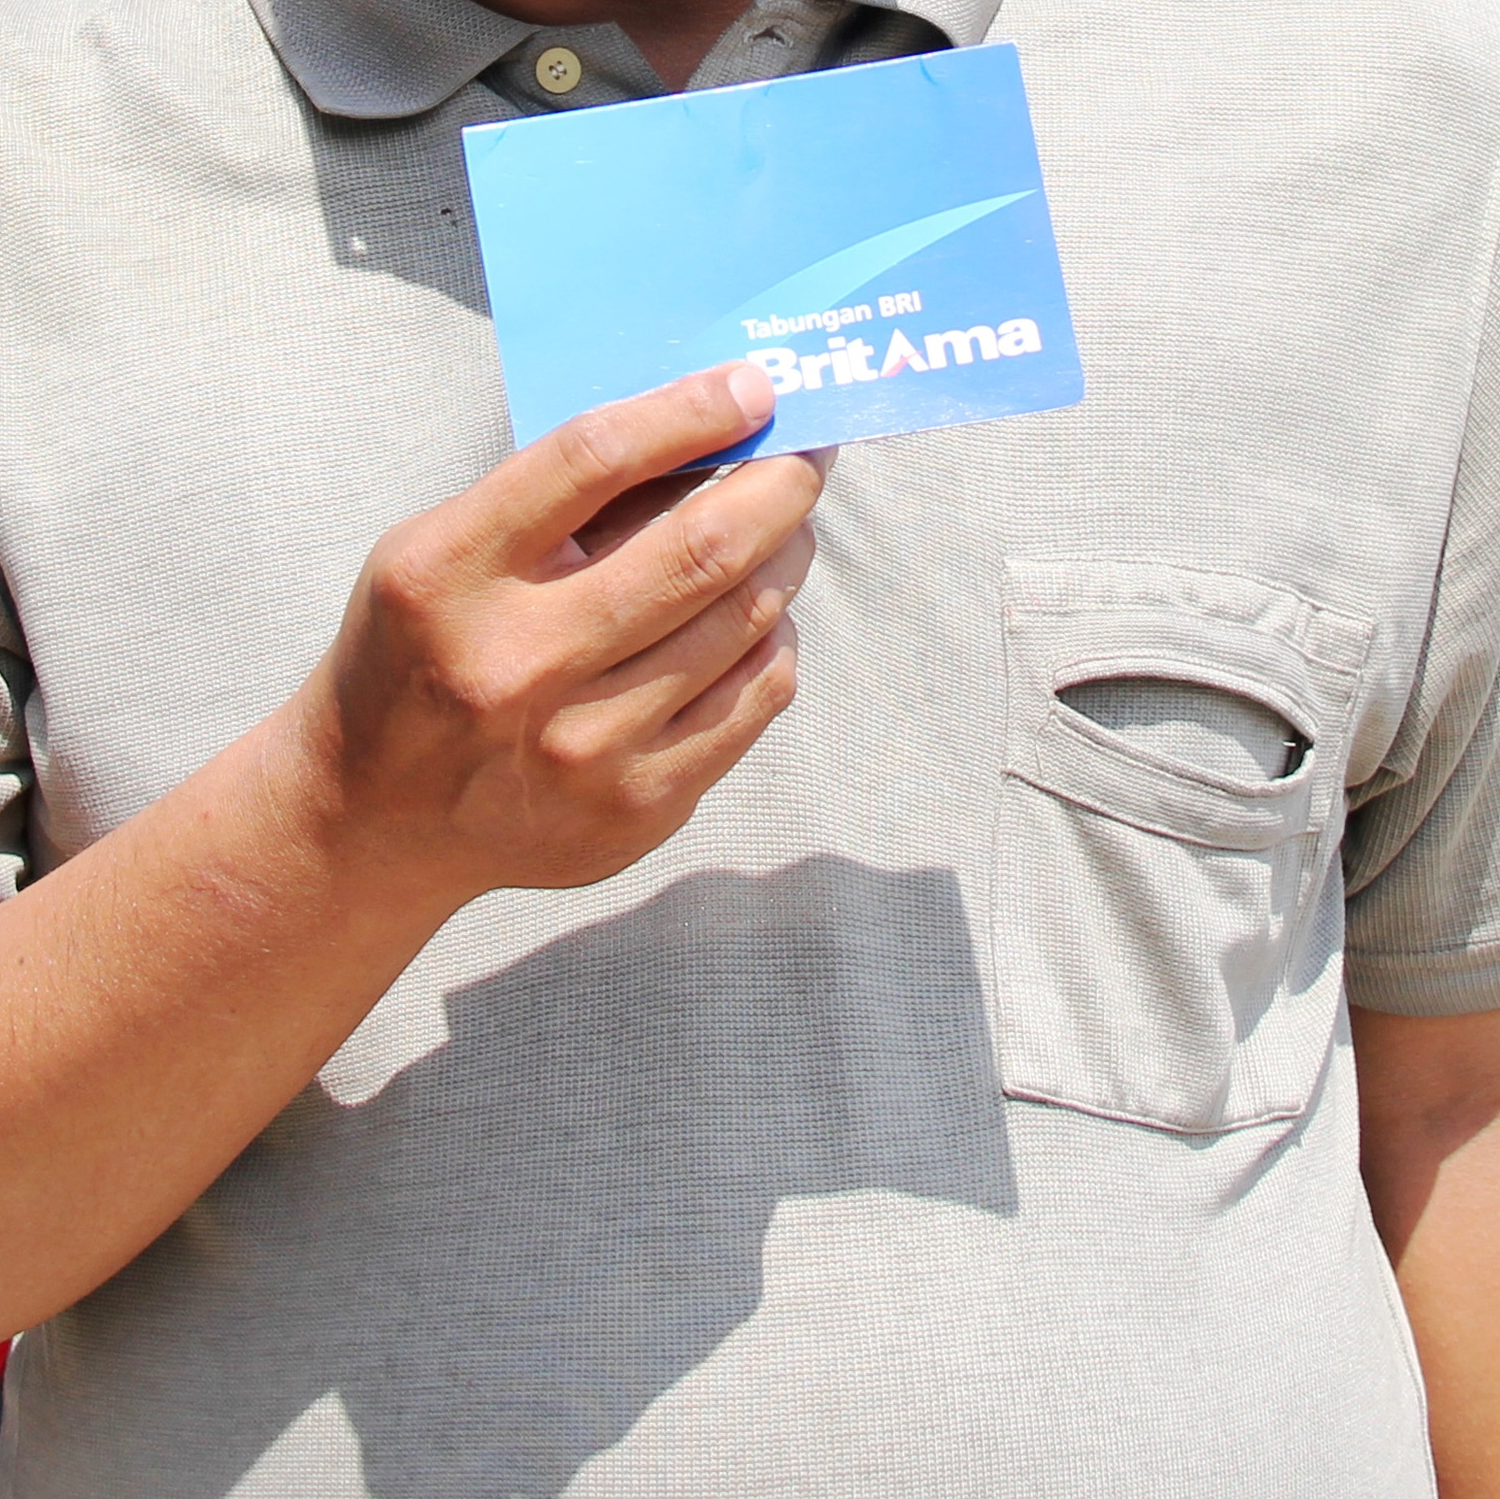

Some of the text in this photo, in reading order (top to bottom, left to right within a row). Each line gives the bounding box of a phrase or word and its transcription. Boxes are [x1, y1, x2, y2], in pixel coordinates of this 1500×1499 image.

[741, 290, 923, 340] Tabungan BRI
[745, 317, 1043, 396] BritAma
